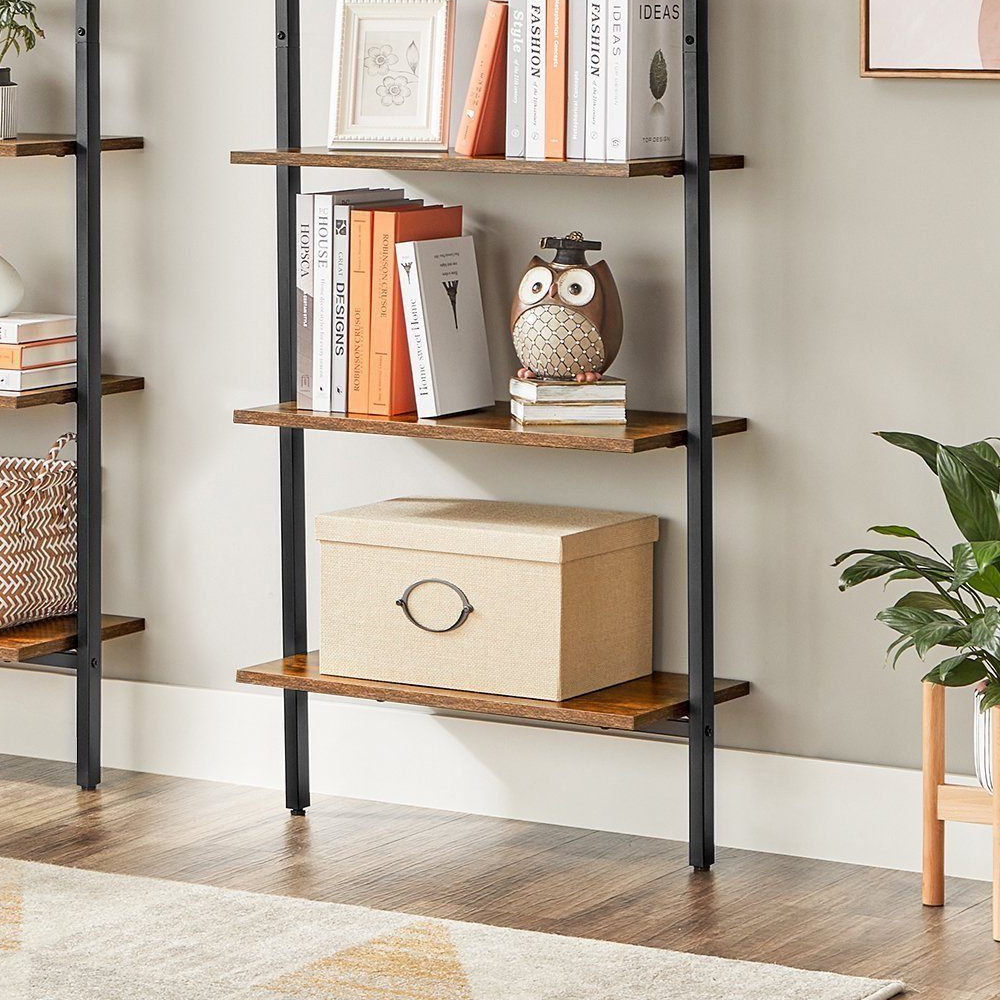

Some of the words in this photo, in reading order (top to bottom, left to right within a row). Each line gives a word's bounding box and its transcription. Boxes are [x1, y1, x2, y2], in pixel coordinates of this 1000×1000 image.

[513, 10, 524, 53] Style
[612, 6, 621, 56] IDEAS
[639, 4, 680, 20] IDEAS
[531, 5, 540, 78] FASHION
[591, 3, 600, 77] FASHION
[300, 224, 310, 277] HOPSCA
[318, 216, 328, 269] HOUSE
[336, 283, 344, 356] DESIGNS
[380, 282, 388, 318] CRUSOE
[410, 298, 419, 331] Home
[415, 334, 423, 363] sweet
[419, 364, 428, 395] Home
